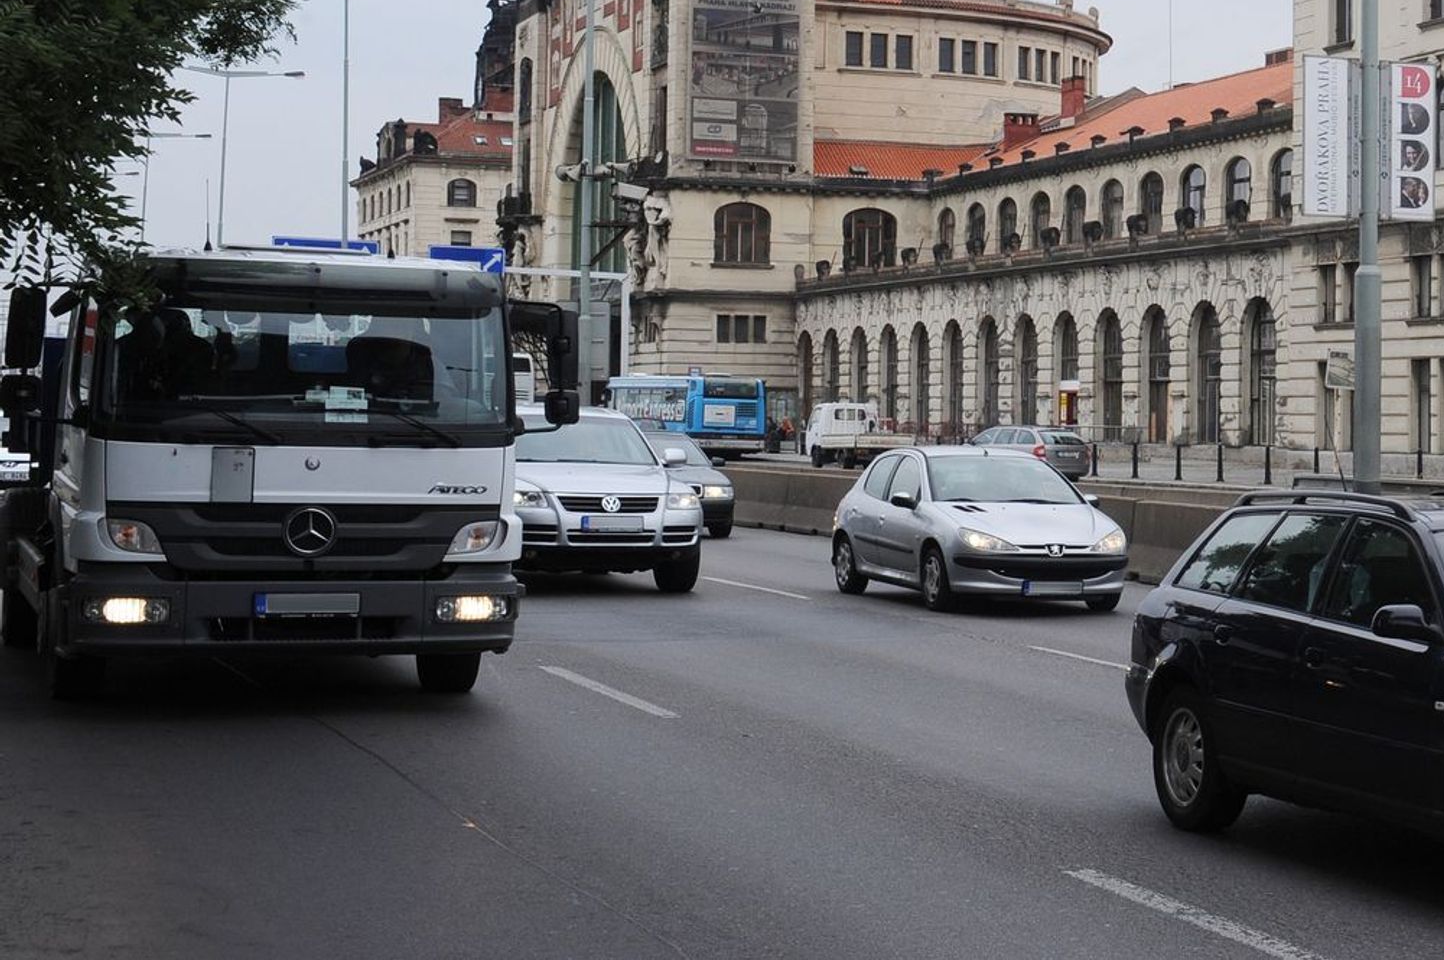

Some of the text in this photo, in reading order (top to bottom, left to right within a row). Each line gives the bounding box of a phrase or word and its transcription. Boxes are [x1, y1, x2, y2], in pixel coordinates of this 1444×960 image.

[1315, 59, 1329, 213] DVOŘÁKOVA PRAHA
[1330, 139, 1338, 213] INTERNATIONAL
[427, 484, 488, 495] ATEGO
